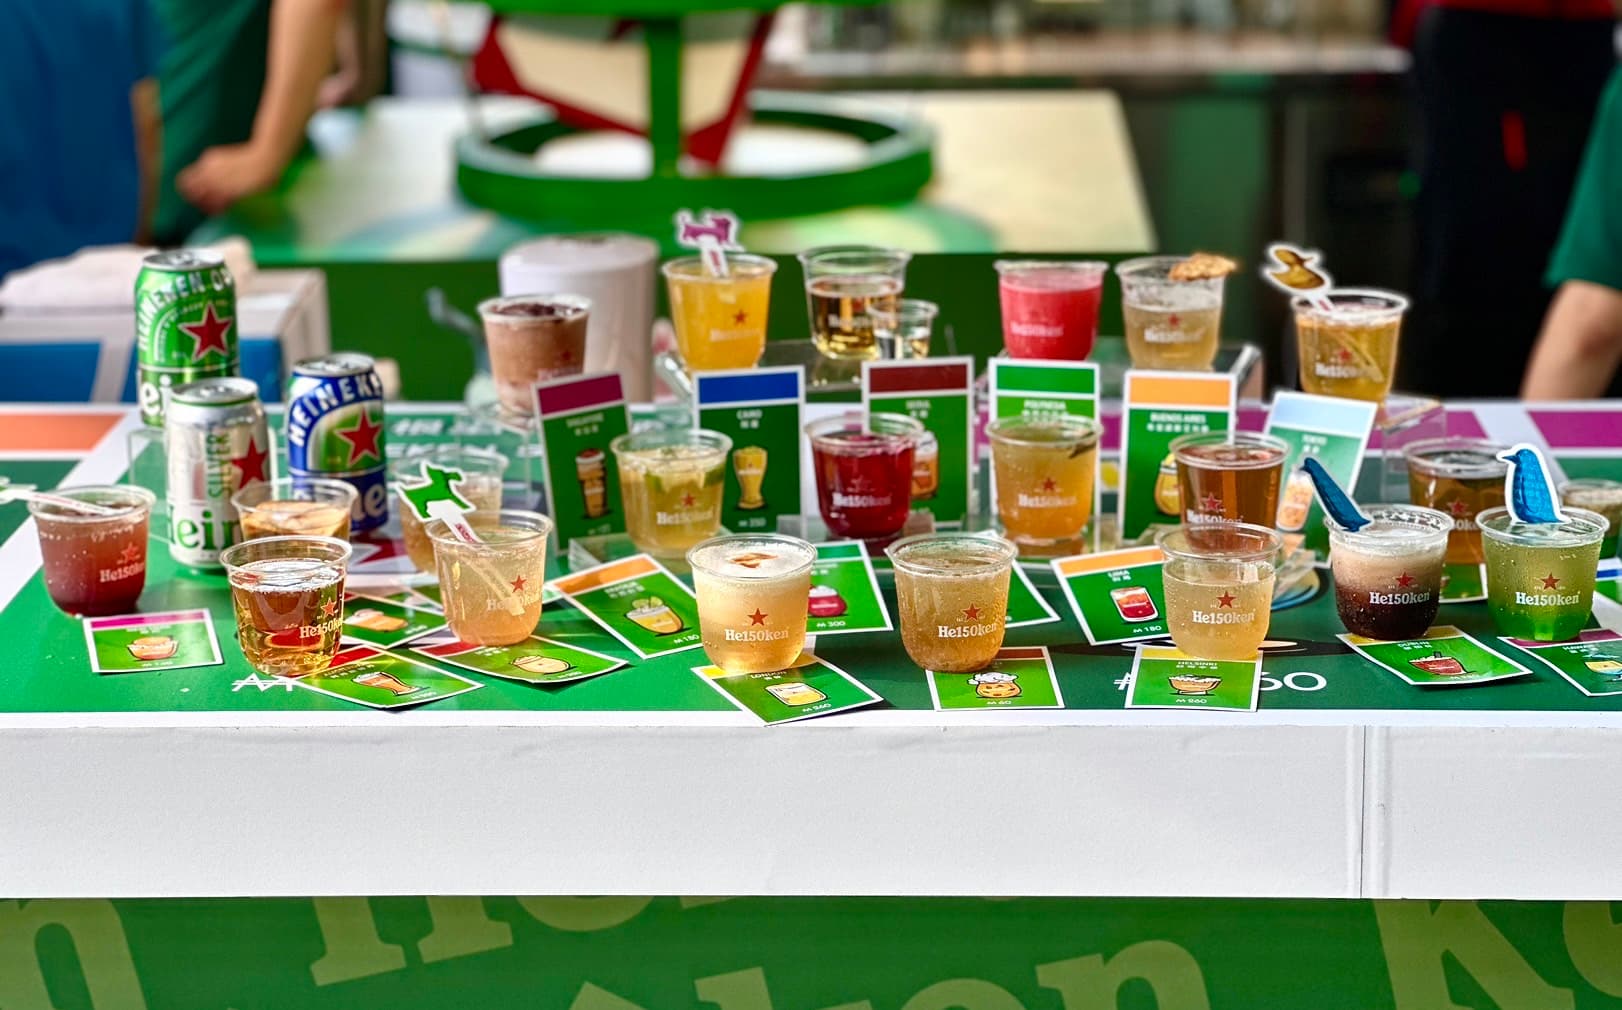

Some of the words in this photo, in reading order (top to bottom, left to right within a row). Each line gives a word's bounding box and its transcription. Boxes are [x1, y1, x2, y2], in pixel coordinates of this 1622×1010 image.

[205, 433, 233, 498] SILVER
[1369, 591, 1431, 605] He150ken
[1515, 591, 1580, 606] He150ken
[1192, 610, 1255, 624] He150ken
[724, 628, 789, 641] He150ken
[938, 621, 997, 638] He150ken
